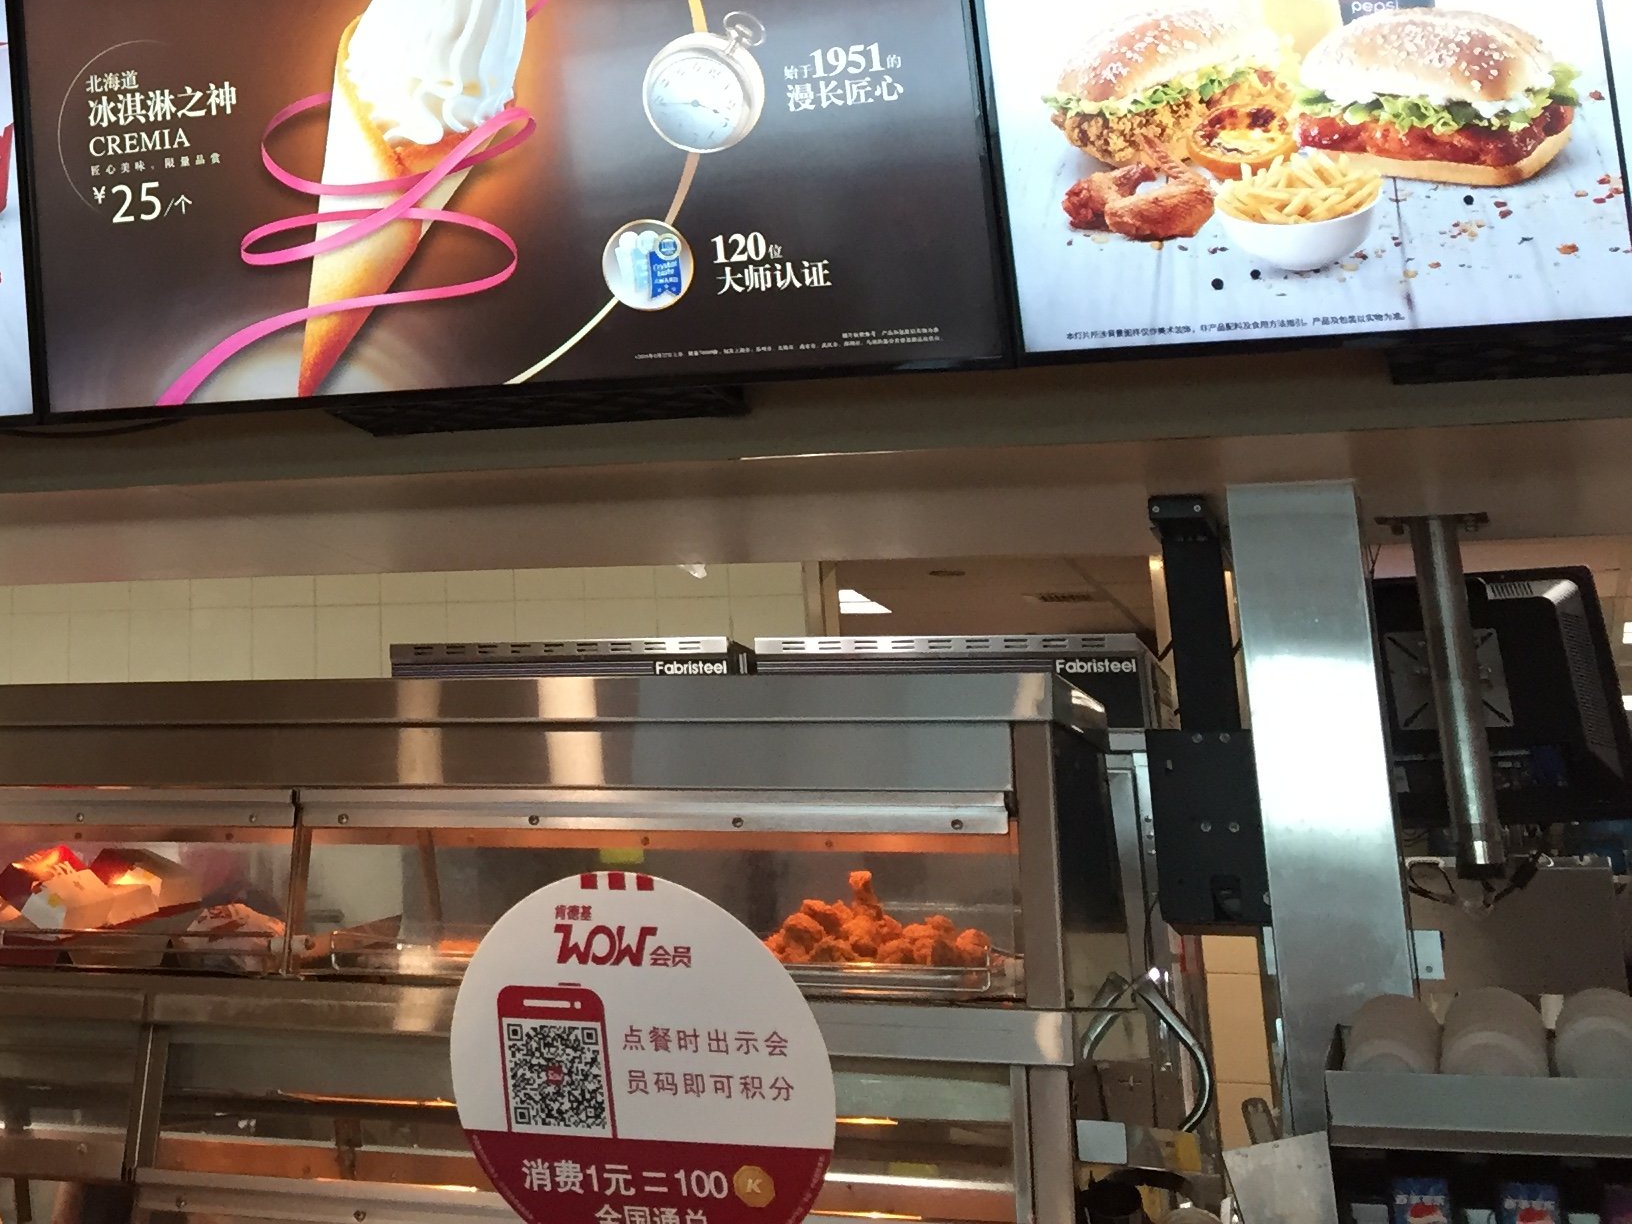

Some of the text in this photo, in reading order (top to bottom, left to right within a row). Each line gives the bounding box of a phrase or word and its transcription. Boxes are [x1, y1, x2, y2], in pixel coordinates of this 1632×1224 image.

[86, 70, 139, 93] 北海道
[786, 75, 904, 112] 漫长匠心
[88, 81, 237, 127] 冰淇淋之神
[89, 128, 191, 157] CREMIA
[716, 259, 832, 295] 大师认证
[655, 660, 727, 675] Fabristeel
[1055, 658, 1137, 674] Fabristeel
[554, 904, 592, 921] 肯德基
[554, 923, 692, 968] WOW 会员
[622, 1025, 789, 1058] 点餐时出示会
[627, 1069, 795, 1102] 员码即可积分
